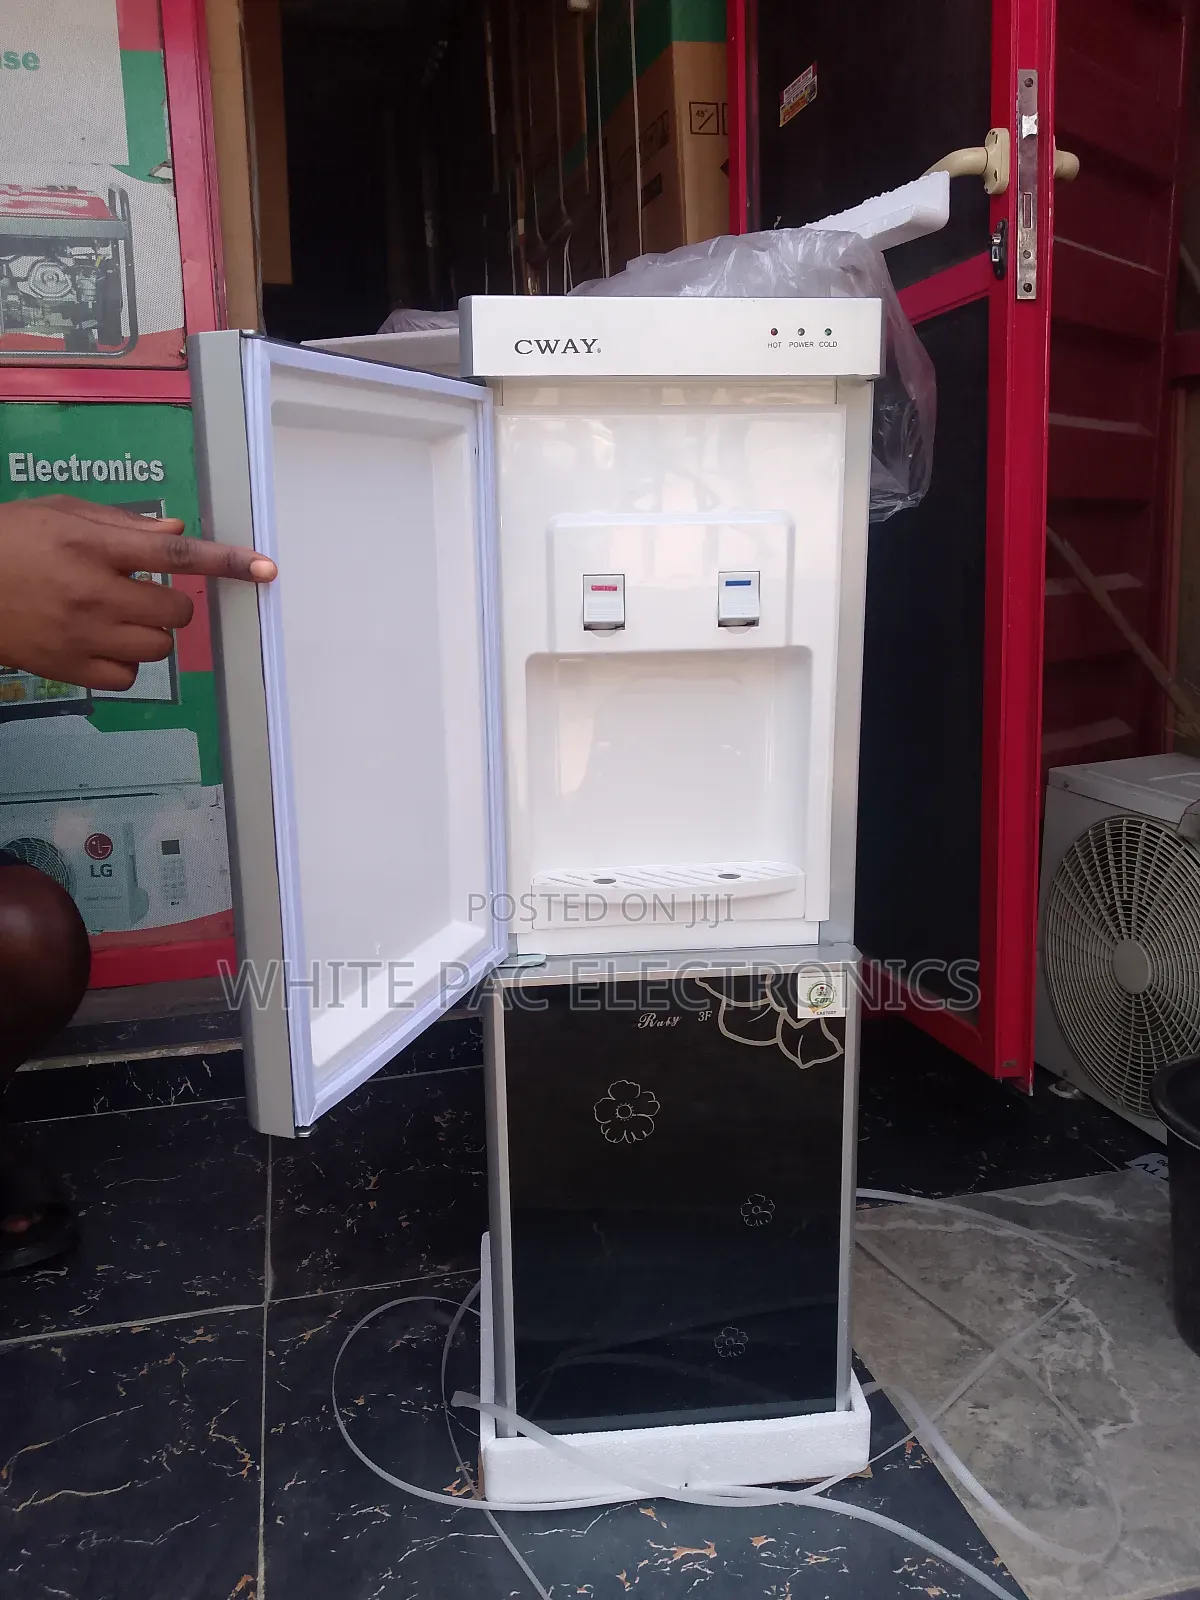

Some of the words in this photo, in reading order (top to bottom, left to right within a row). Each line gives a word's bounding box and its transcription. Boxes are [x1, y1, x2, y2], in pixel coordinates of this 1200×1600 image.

[0, 51, 40, 71] se
[8, 452, 165, 482] Electronics
[90, 864, 113, 878] LG
[698, 1010, 713, 1022] 3F
